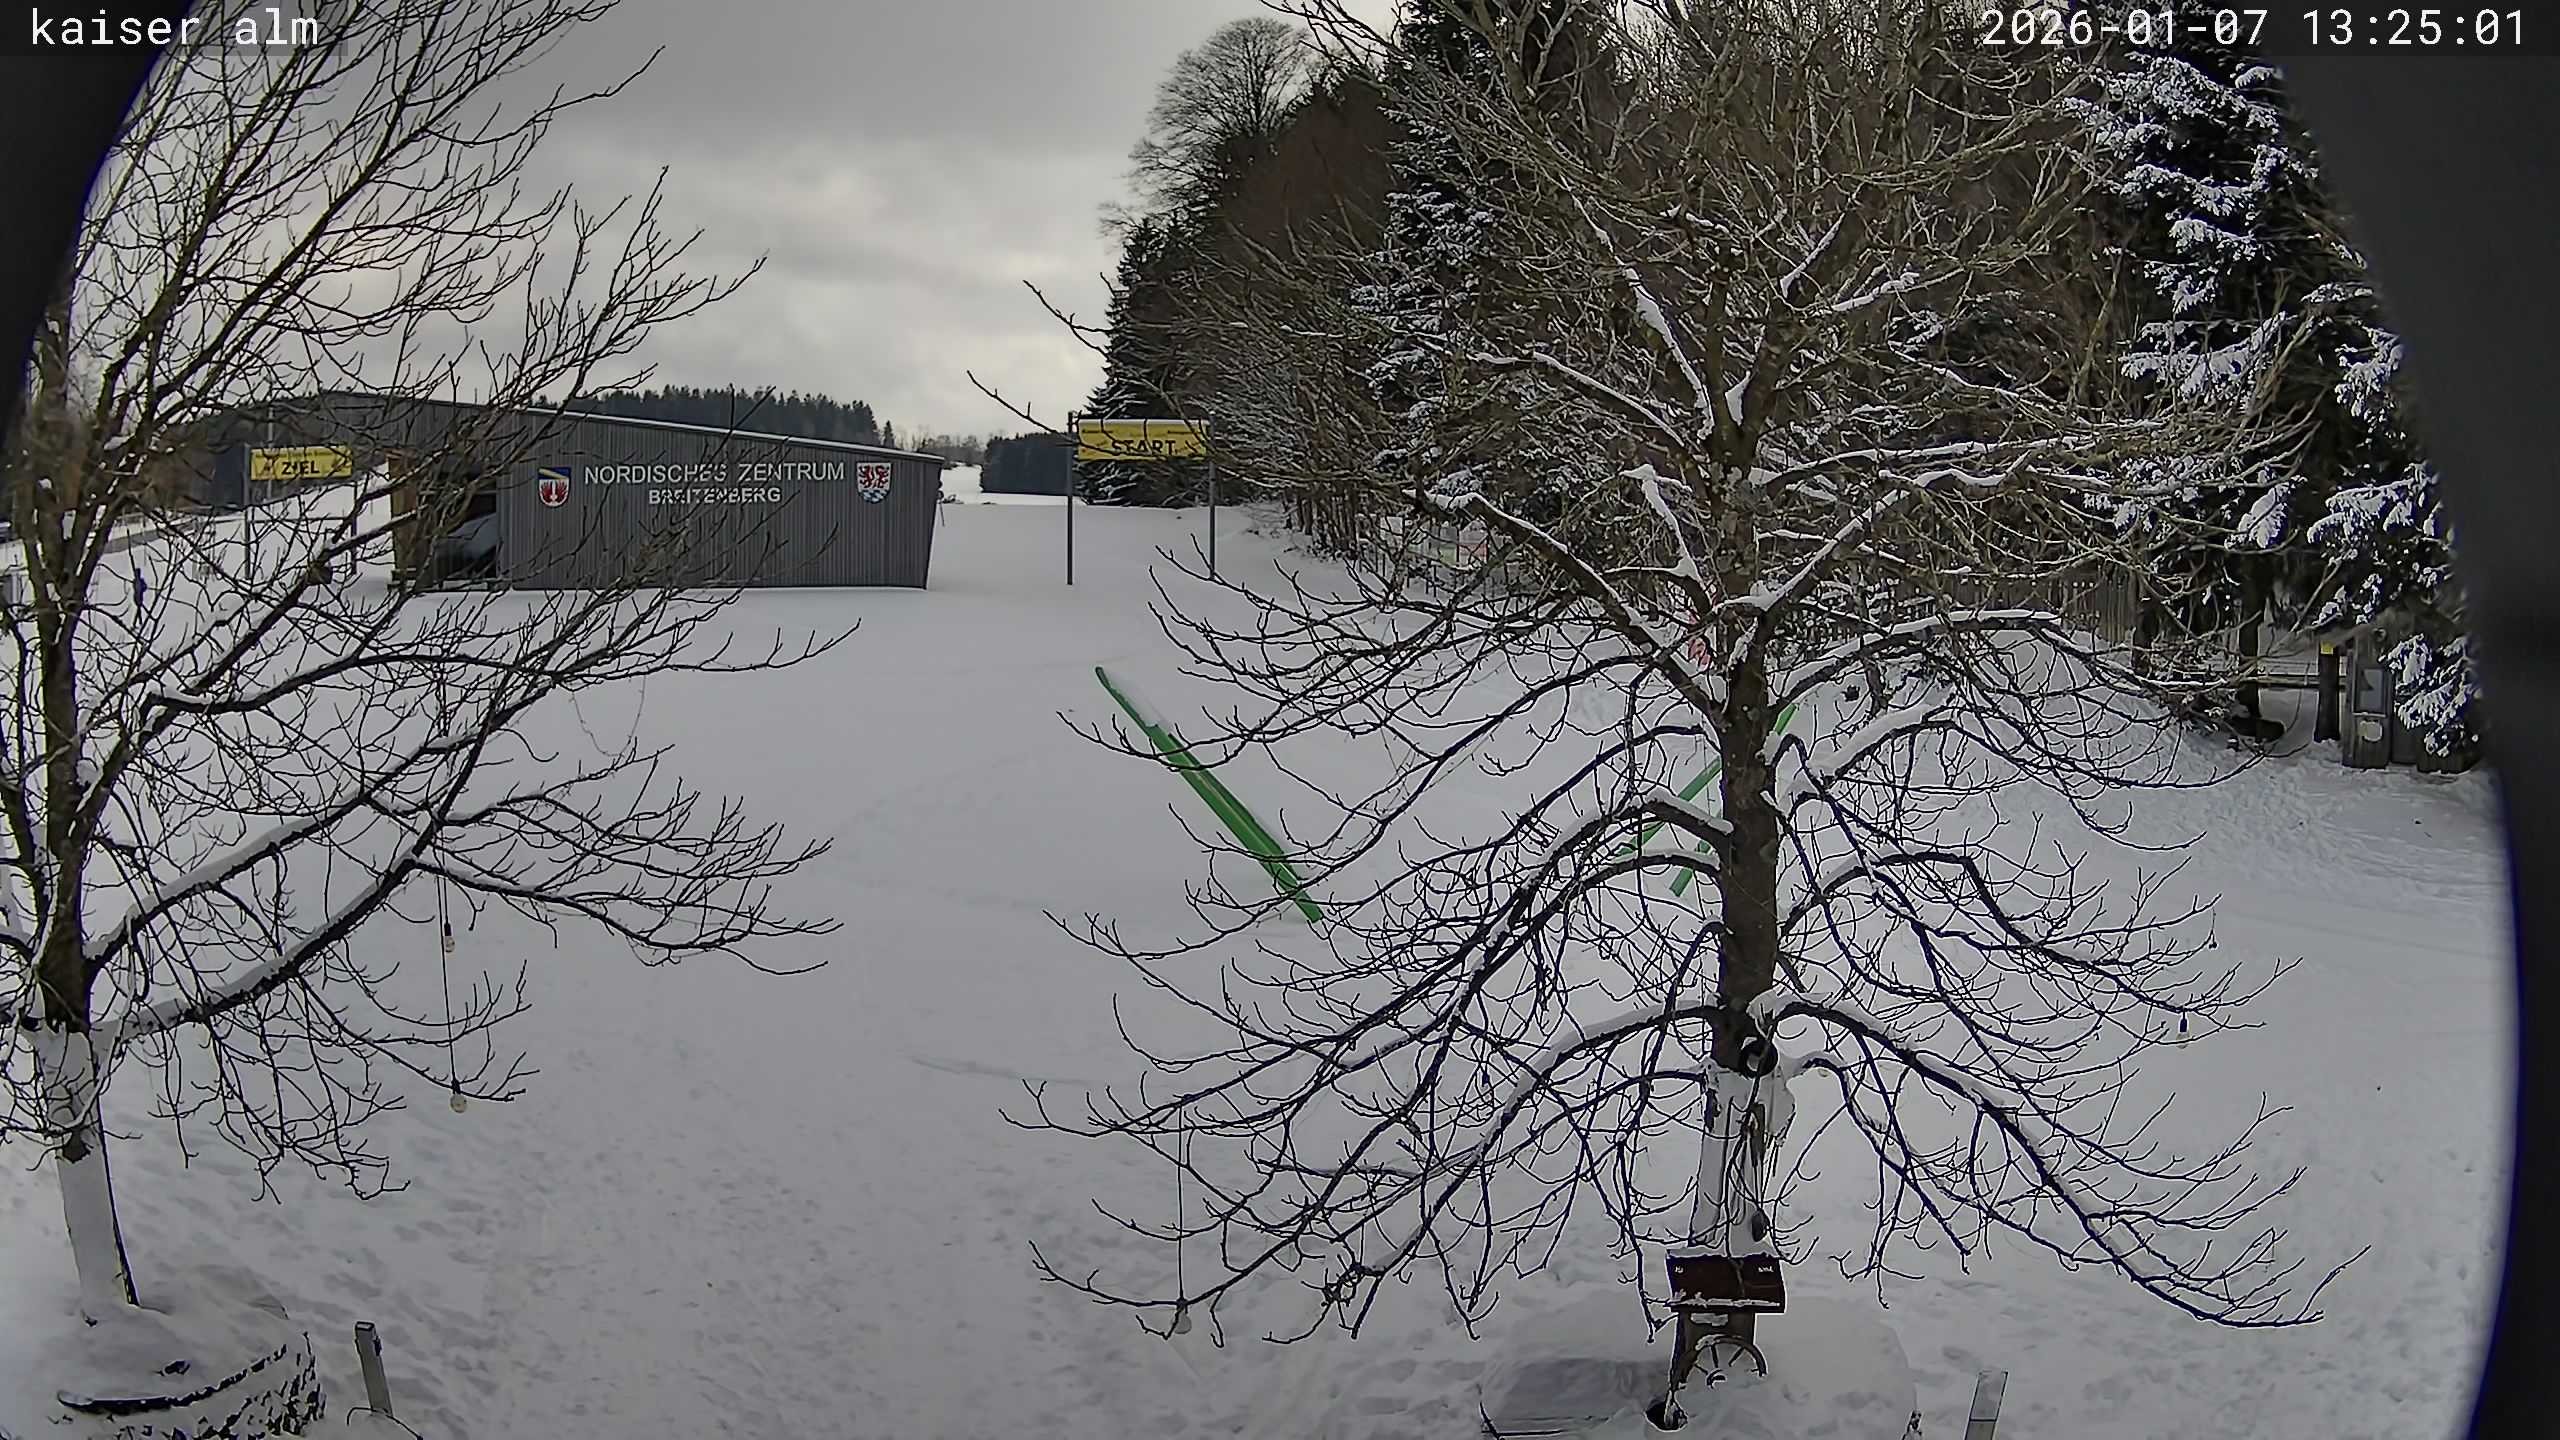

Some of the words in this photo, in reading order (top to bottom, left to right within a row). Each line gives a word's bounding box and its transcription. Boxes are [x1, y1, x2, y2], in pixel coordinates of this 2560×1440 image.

[1111, 440, 1176, 456] START
[281, 460, 320, 475] ZIEL
[584, 463, 728, 484] NORDISCHES
[738, 462, 845, 481] ZENTRUM
[648, 487, 781, 504] BREITENBERG
